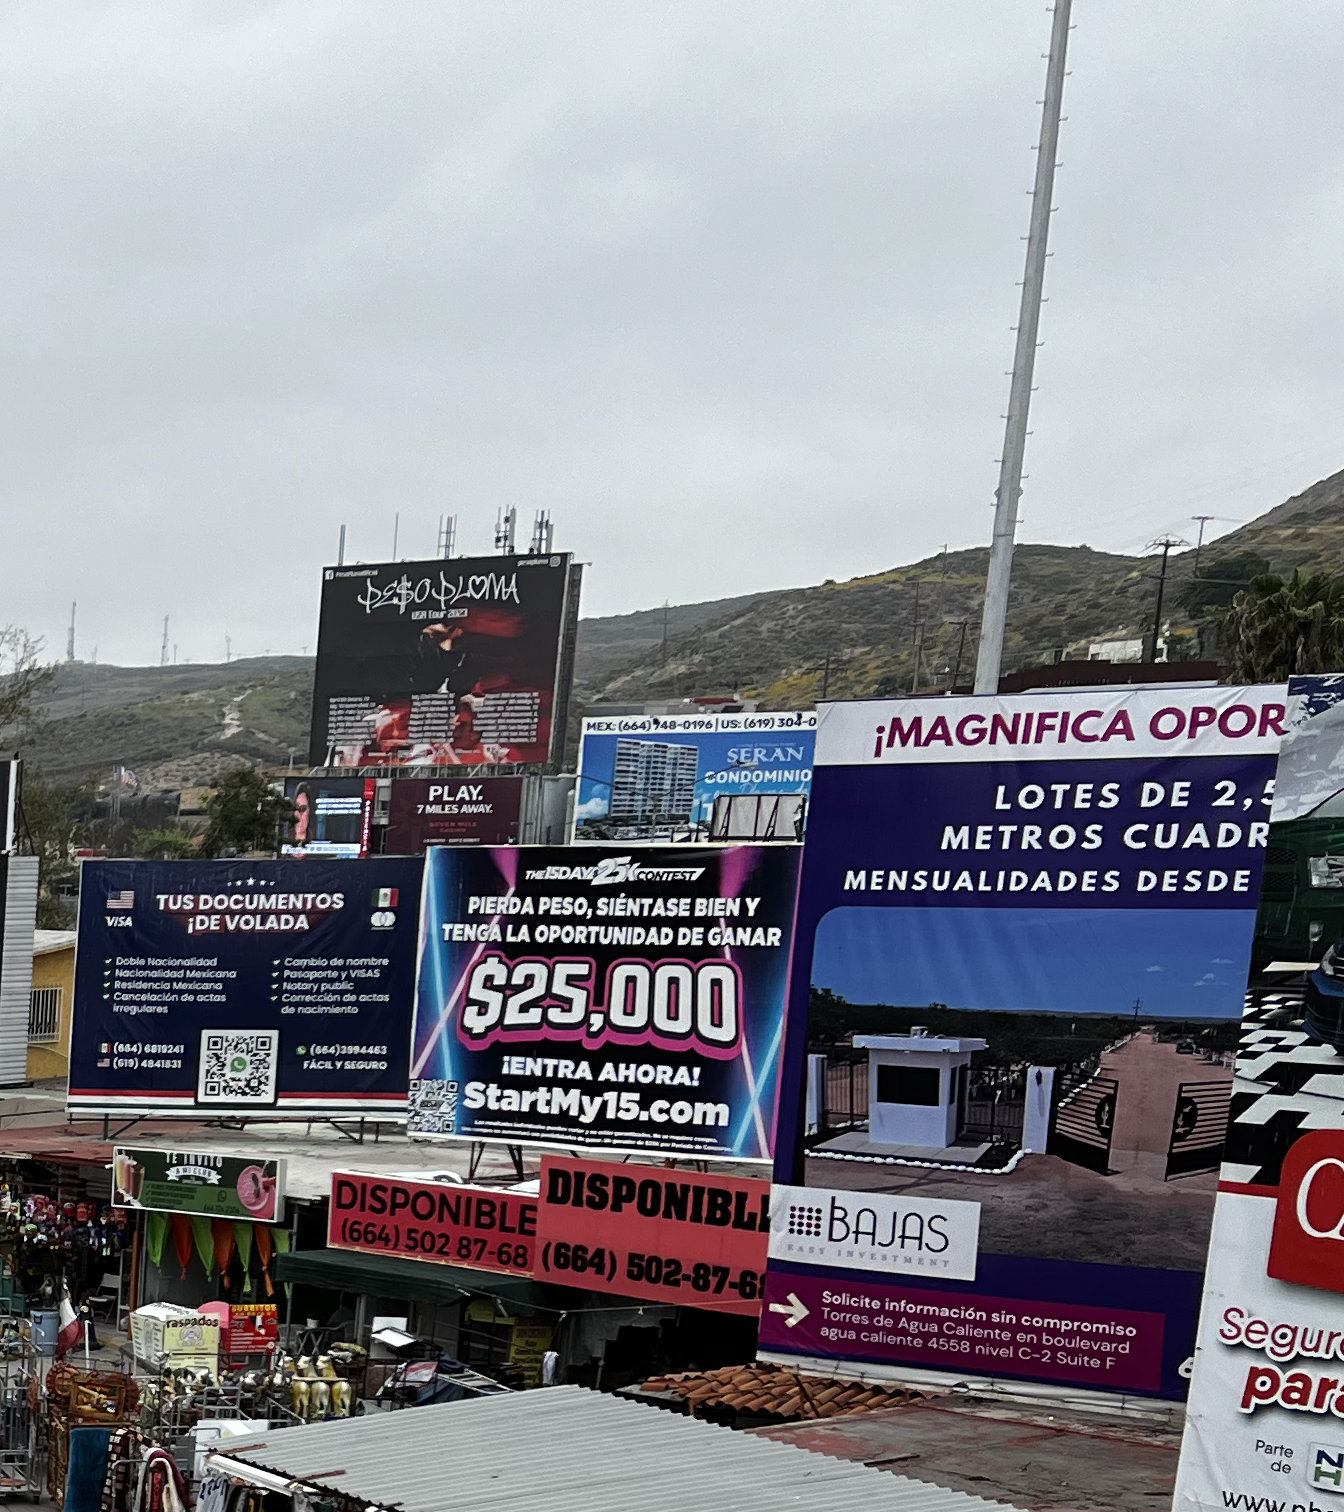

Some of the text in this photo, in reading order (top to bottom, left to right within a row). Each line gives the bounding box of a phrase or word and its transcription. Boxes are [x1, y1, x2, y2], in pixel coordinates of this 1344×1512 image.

[428, 608, 468, 619] Tour 2023
[587, 718, 774, 732] MEX: (664) US: (619)
[874, 709, 1135, 757] ¡MAGNIFICA
[727, 747, 803, 763] SERAN
[429, 785, 483, 801] PLAY.
[994, 781, 1192, 811] LOTES DE
[417, 804, 493, 814] 7 MILES AWAY.
[940, 824, 1104, 852] METROS
[636, 870, 698, 881] CONTEST
[844, 869, 1251, 894] MENSUALIDADES DESDE
[156, 892, 344, 911] TUS DOCUMENTOS
[468, 893, 761, 919] PIERDA PESO, SIÉNTASE BIEN Y
[105, 915, 132, 928] VISA
[187, 914, 309, 935] ¡DE VOLADA
[442, 923, 782, 947] TENGA LA OPORTUNIDAD DE GANAR
[116, 957, 218, 967] Doble Nacionalidad
[284, 957, 389, 968] Cambio de nombre
[115, 969, 237, 979] Nacionalidad Mexicana
[283, 969, 381, 981] Pasaporte VISAS
[114, 980, 223, 991] Residencia Mexicana
[282, 982, 319, 992] Notary
[113, 992, 226, 1002] Cancelación de actas
[281, 993, 357, 1002] Corrección de
[463, 957, 736, 1042] $25,000
[113, 1003, 168, 1015] irregulares
[281, 1005, 359, 1014] de nacimiento
[344, 1061, 388, 1070] SEGURO
[501, 1055, 701, 1087] ¡ENTRA AHORA!
[463, 1081, 730, 1127] StartMy15.com
[334, 1180, 537, 1237] DISPONIBLE
[341, 1217, 529, 1267] (664) 502 87-68
[541, 1240, 616, 1282] (664)
[837, 1248, 950, 1268] INVESTMENT
[166, 1316, 218, 1329] raspados
[821, 1291, 1137, 1339] Solicite información sin compromiso
[821, 1307, 1130, 1355] Torres de Agua Caliente en boulevard
[820, 1328, 1117, 1370] agua caliente 4558 nivel Suite F
[1256, 1439, 1294, 1459] Parte
[1270, 1459, 1292, 1475] de
